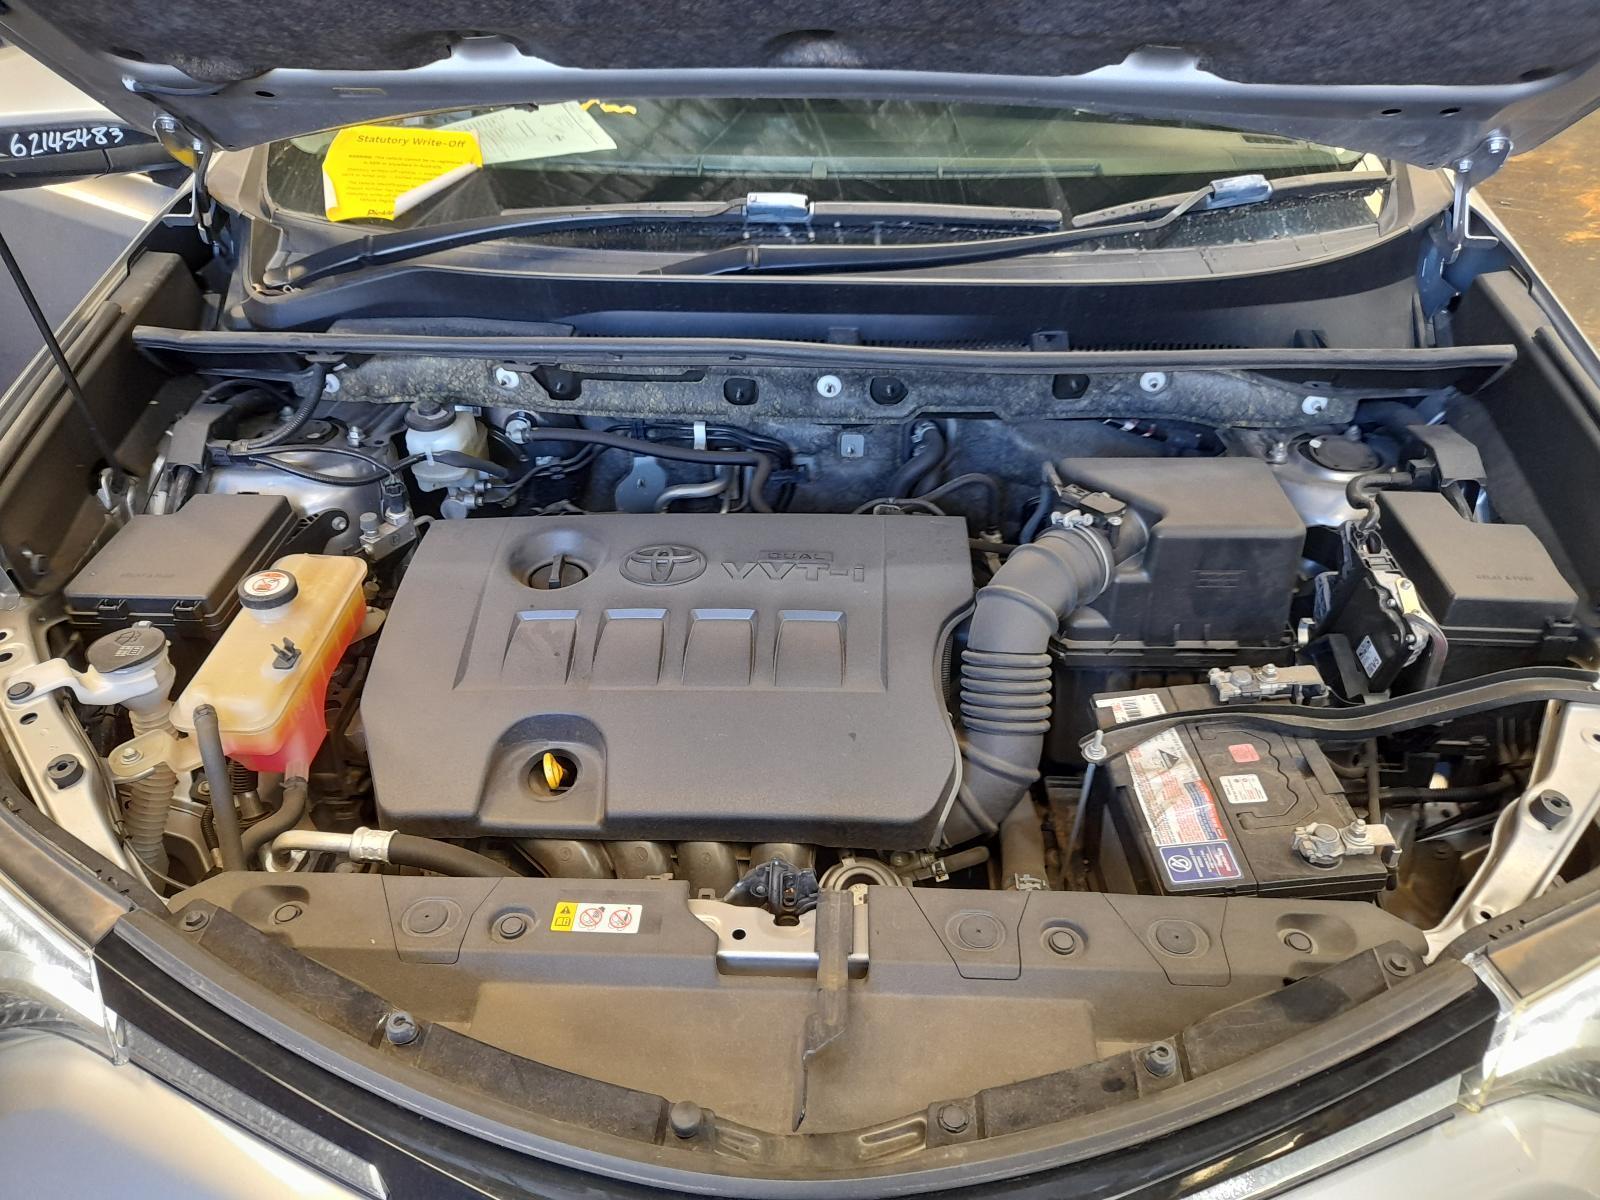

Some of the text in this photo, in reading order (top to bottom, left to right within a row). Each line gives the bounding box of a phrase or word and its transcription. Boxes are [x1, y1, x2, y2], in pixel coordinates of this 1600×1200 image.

[10, 126, 124, 157] 62145483
[356, 135, 467, 148] Statutory Write-Off
[767, 552, 828, 561] DUAL
[720, 561, 865, 582] VVT-i
